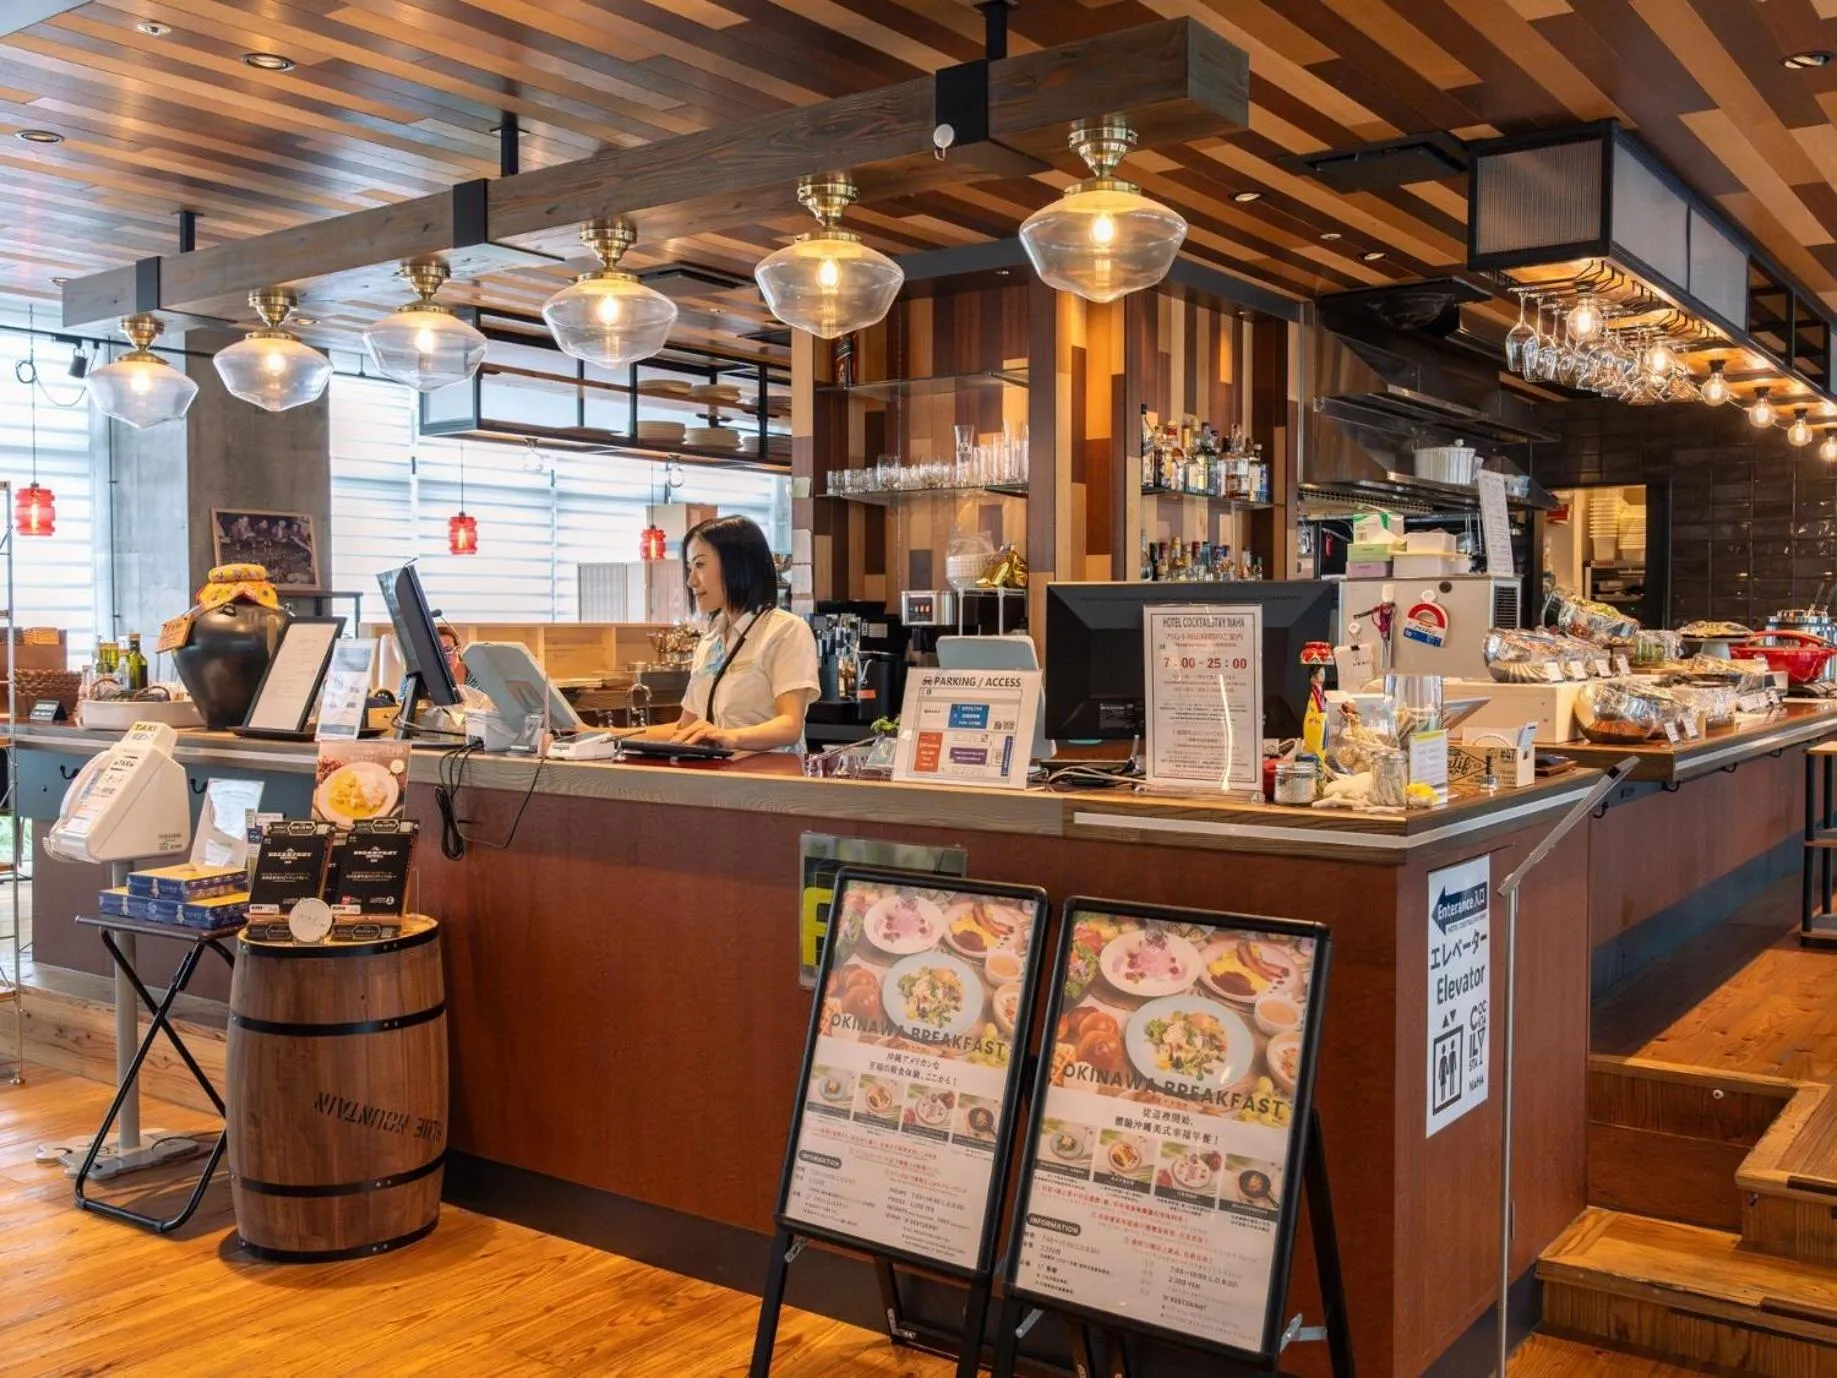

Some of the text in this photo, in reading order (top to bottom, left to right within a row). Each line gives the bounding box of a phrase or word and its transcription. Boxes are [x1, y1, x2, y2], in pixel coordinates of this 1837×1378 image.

[934, 676, 976, 687] PARKING
[985, 677, 1021, 687] ACCESS
[1437, 897, 1473, 920] Enterance
[1431, 930, 1487, 970] エレベーター
[1436, 964, 1486, 1005] Elevator
[831, 1013, 1006, 1056] OKINAWA BREAKFAST
[1062, 1064, 1285, 1117] OKINAWA BREAKFAST
[314, 1092, 410, 1134] MOUNTAIN
[1030, 1216, 1078, 1235] INFORMATION
